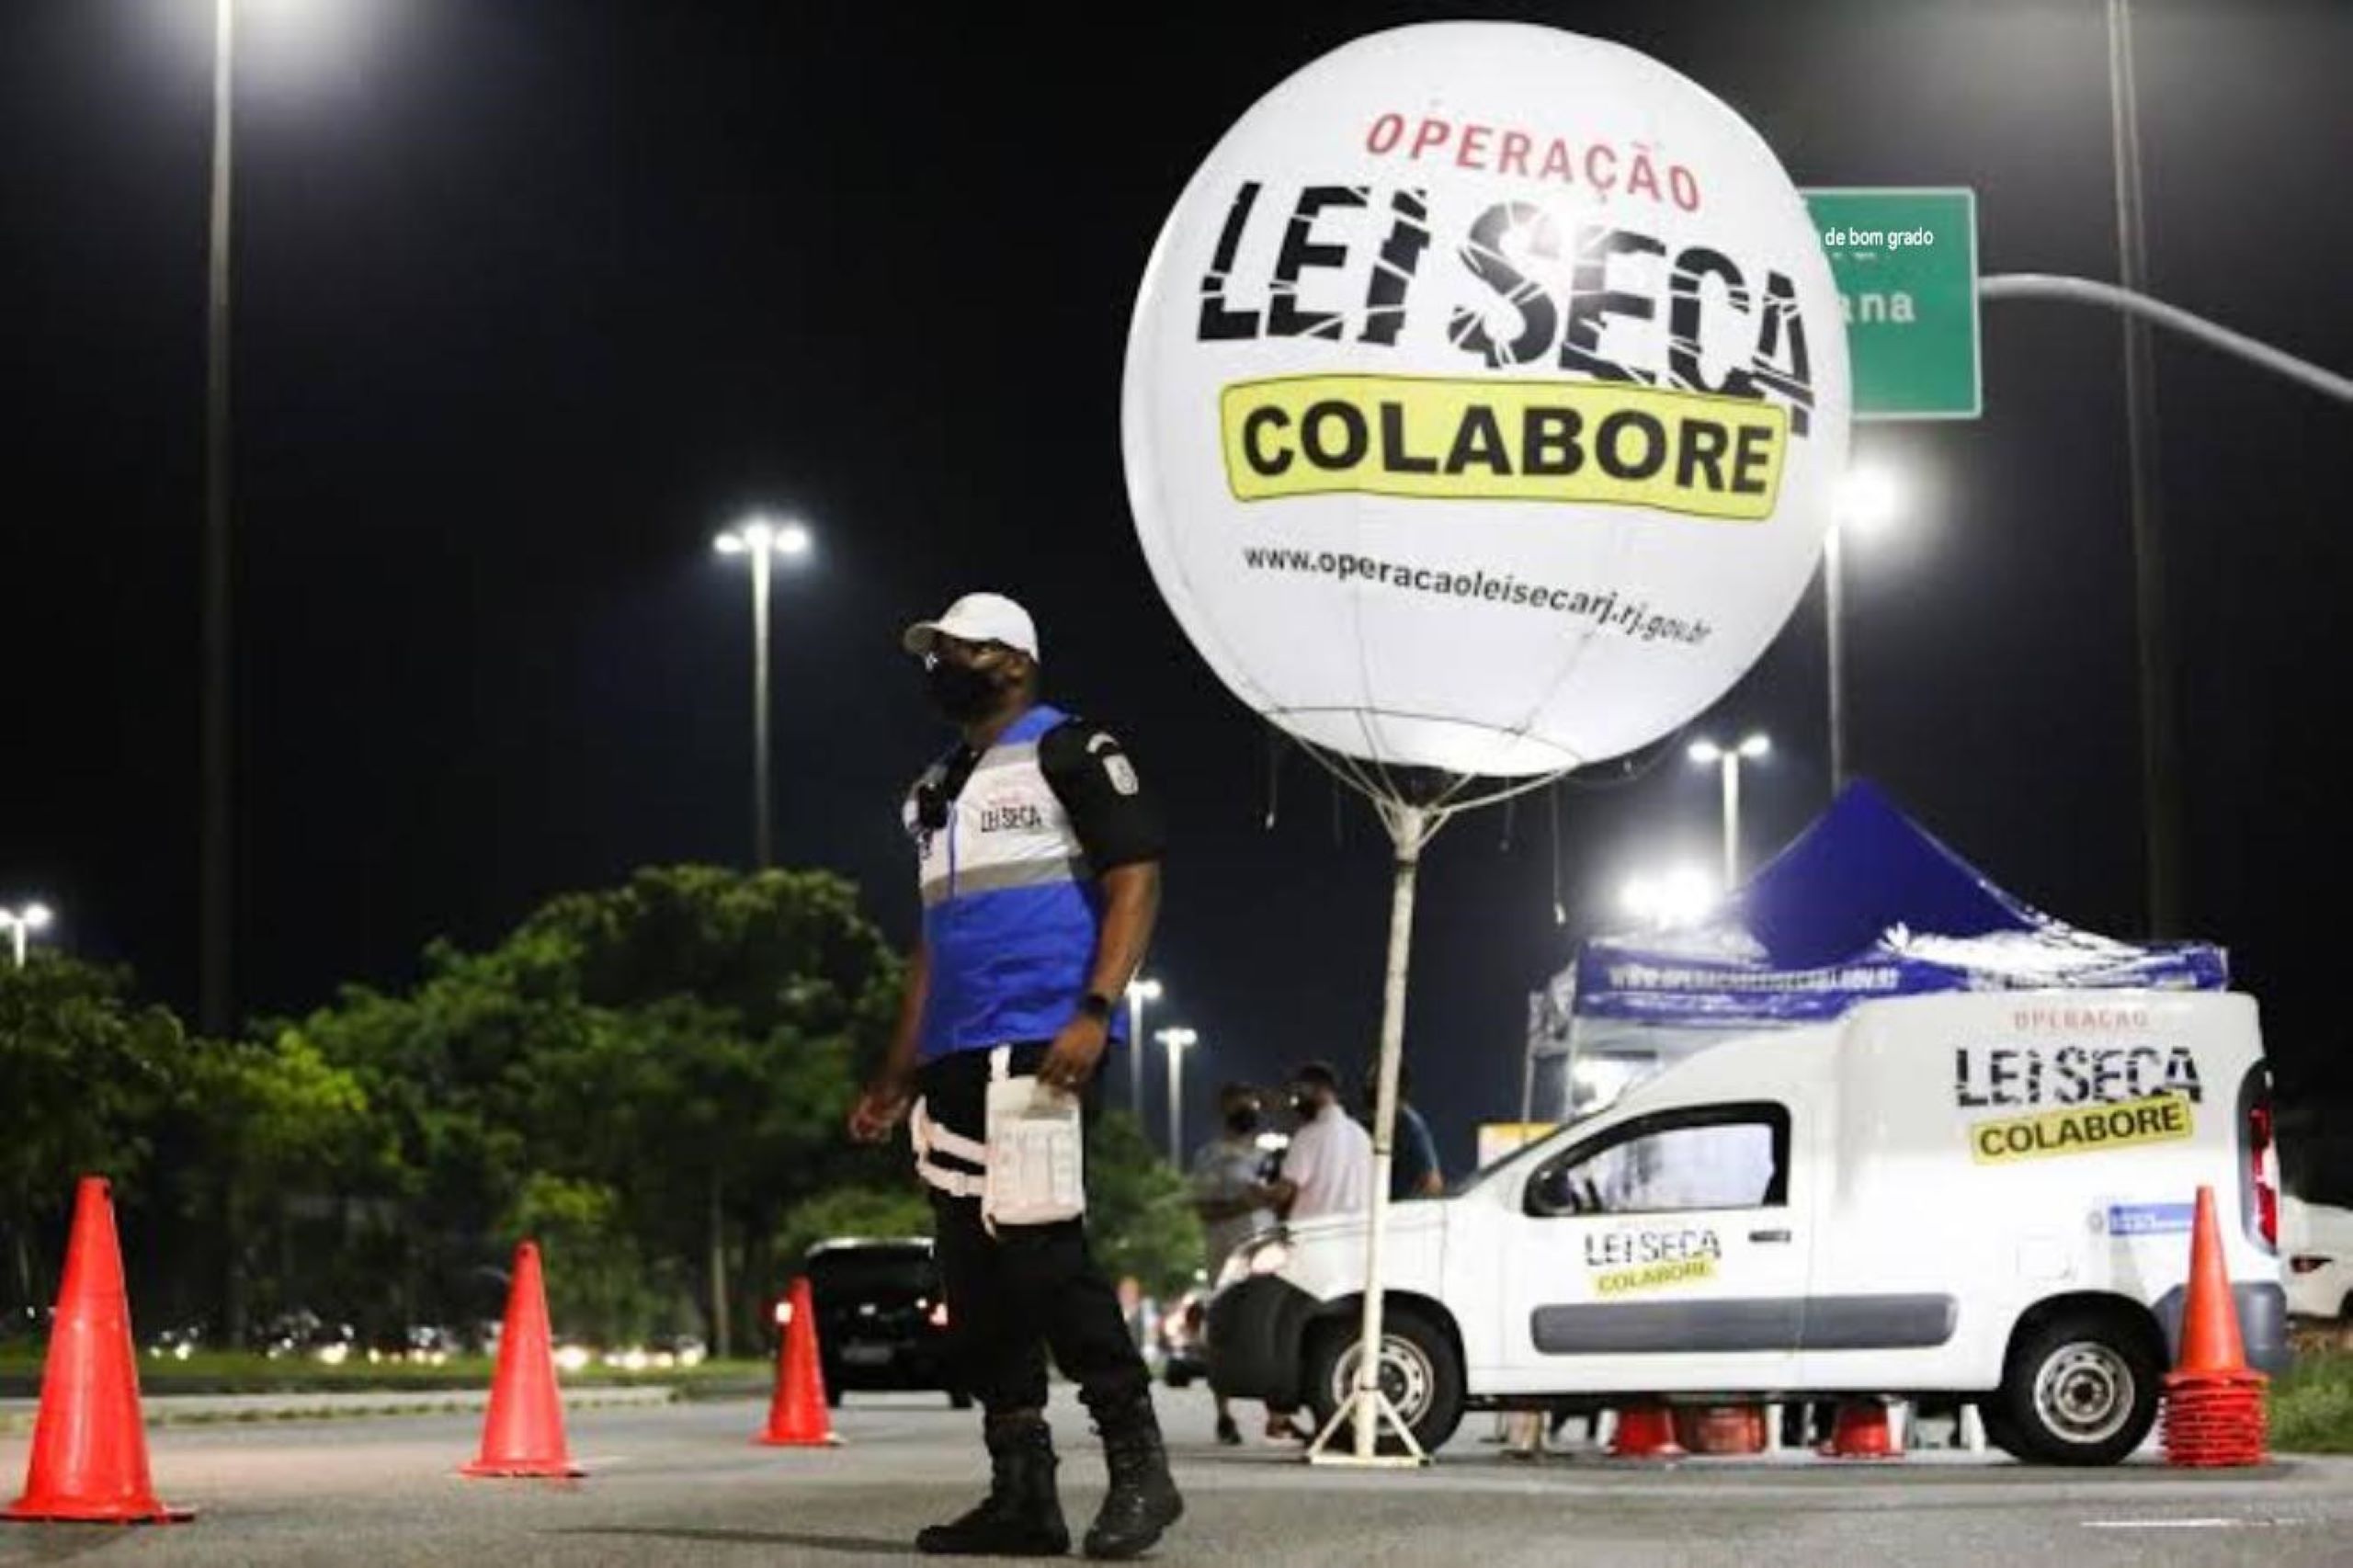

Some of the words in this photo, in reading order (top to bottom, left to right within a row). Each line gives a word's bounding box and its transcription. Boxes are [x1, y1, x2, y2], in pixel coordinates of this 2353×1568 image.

[1366, 109, 1701, 213] OPERAÇÃO
[1197, 181, 1429, 346] LEI
[1447, 200, 1814, 437] SECA
[1243, 401, 1773, 494] COLABORE
[1956, 1048, 2042, 1108] LEI
[2053, 1046, 2202, 1103] SECA
[1979, 1102, 2185, 1156] COLABORE
[1585, 1233, 1631, 1266] LEI
[1640, 1230, 1722, 1262] SECA
